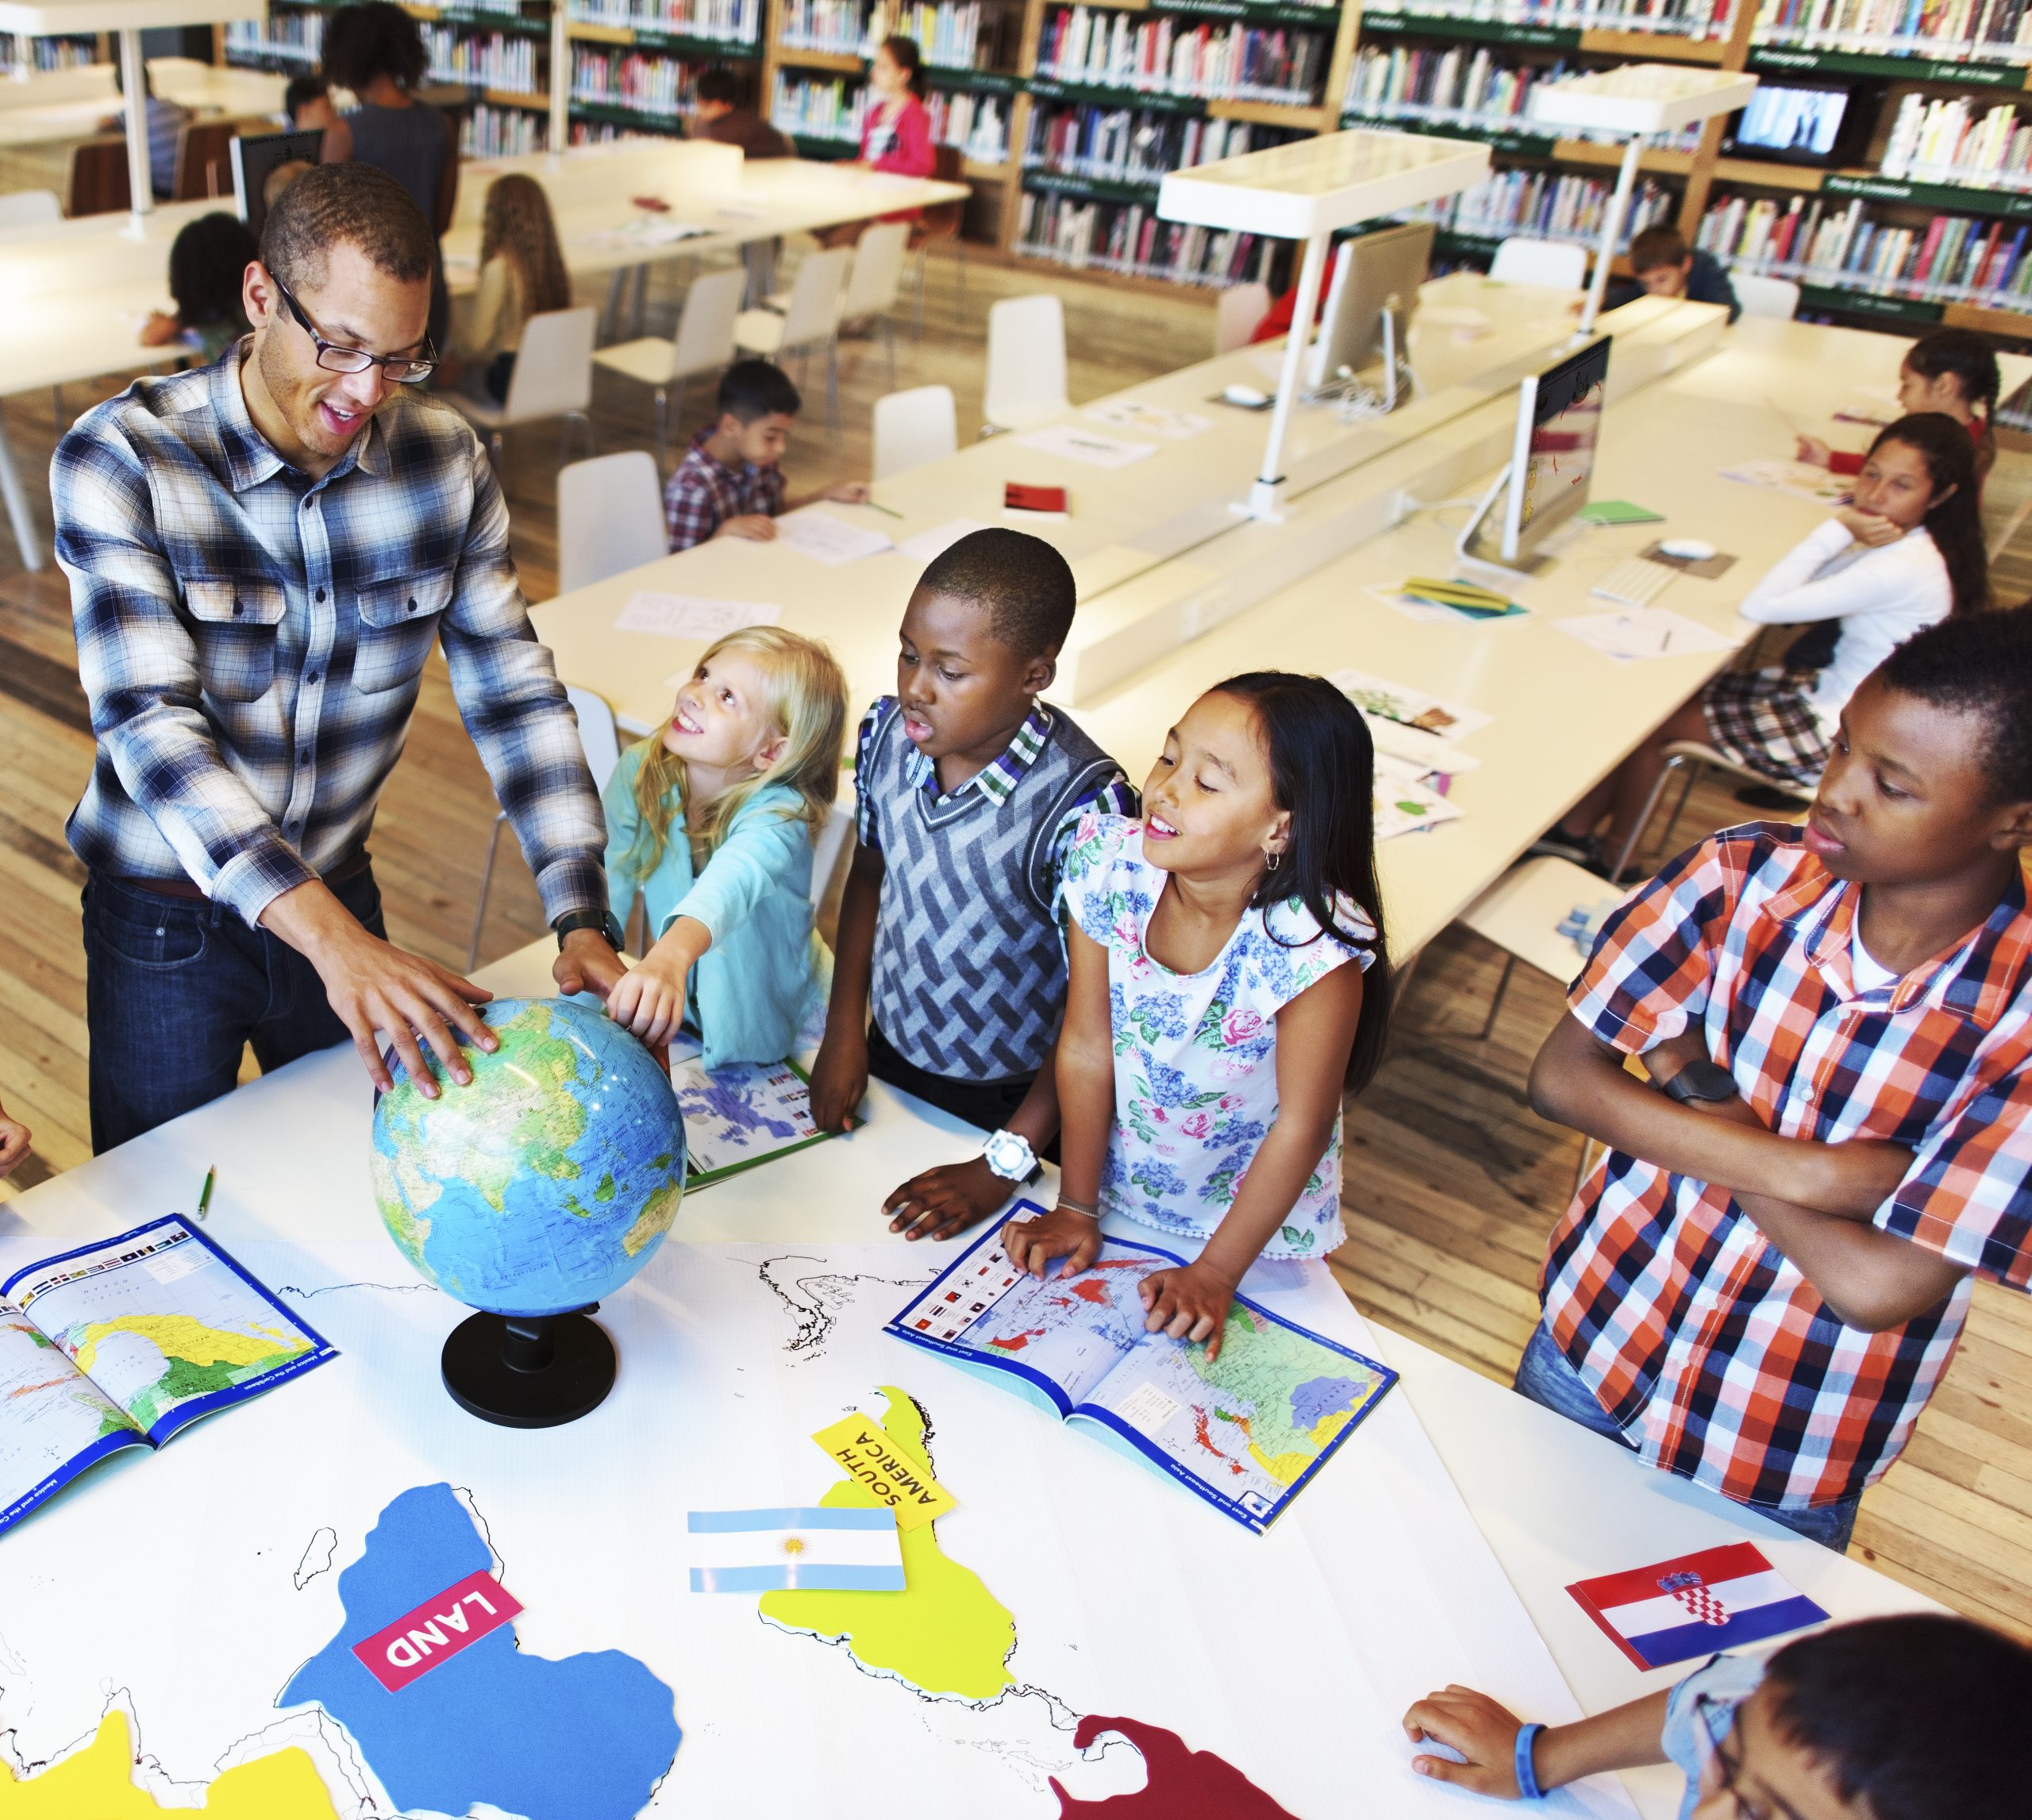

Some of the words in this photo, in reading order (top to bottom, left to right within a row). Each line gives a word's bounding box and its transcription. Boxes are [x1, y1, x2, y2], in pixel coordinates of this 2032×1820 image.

[247, 137, 269, 146] LESSON
[915, 1335, 945, 1349] Southeast
[297, 1355, 318, 1367] Mexico
[244, 1376, 275, 1390] Caribbean
[855, 1431, 937, 1504] AMERICA
[1171, 1464, 1185, 1476] Asia
[836, 1449, 902, 1506] SOUTH
[34, 1479, 58, 1497] Mexico
[1185, 1475, 1218, 1499] Southeast
[21, 1496, 34, 1508] and
[1218, 1498, 1232, 1507] and
[9, 1506, 21, 1516] the
[1232, 1506, 1248, 1519] East
[387, 1591, 498, 1667] LAND
